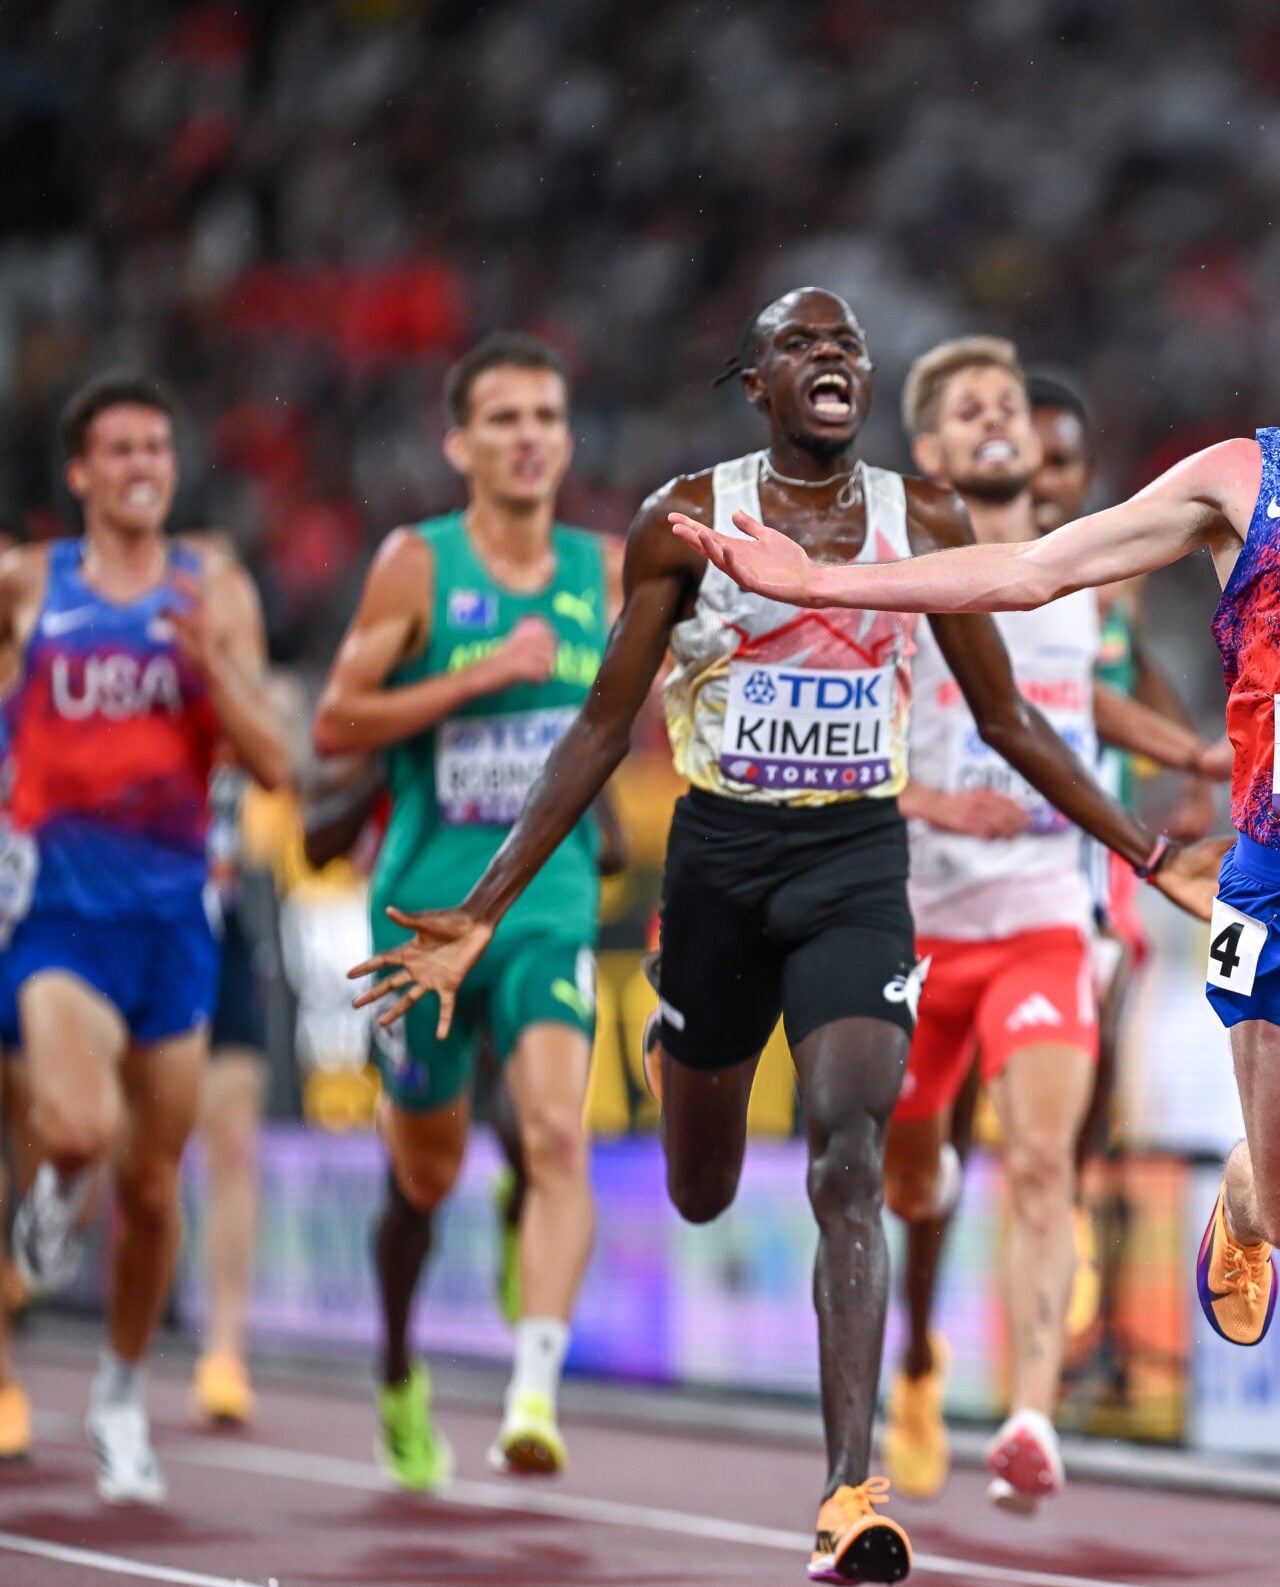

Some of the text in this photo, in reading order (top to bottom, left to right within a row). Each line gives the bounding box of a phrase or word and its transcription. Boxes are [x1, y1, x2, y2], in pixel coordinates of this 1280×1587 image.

[52, 652, 184, 722] USA
[778, 674, 882, 710] TDK
[736, 716, 880, 756] KIMELI
[1209, 921, 1244, 978] 4
